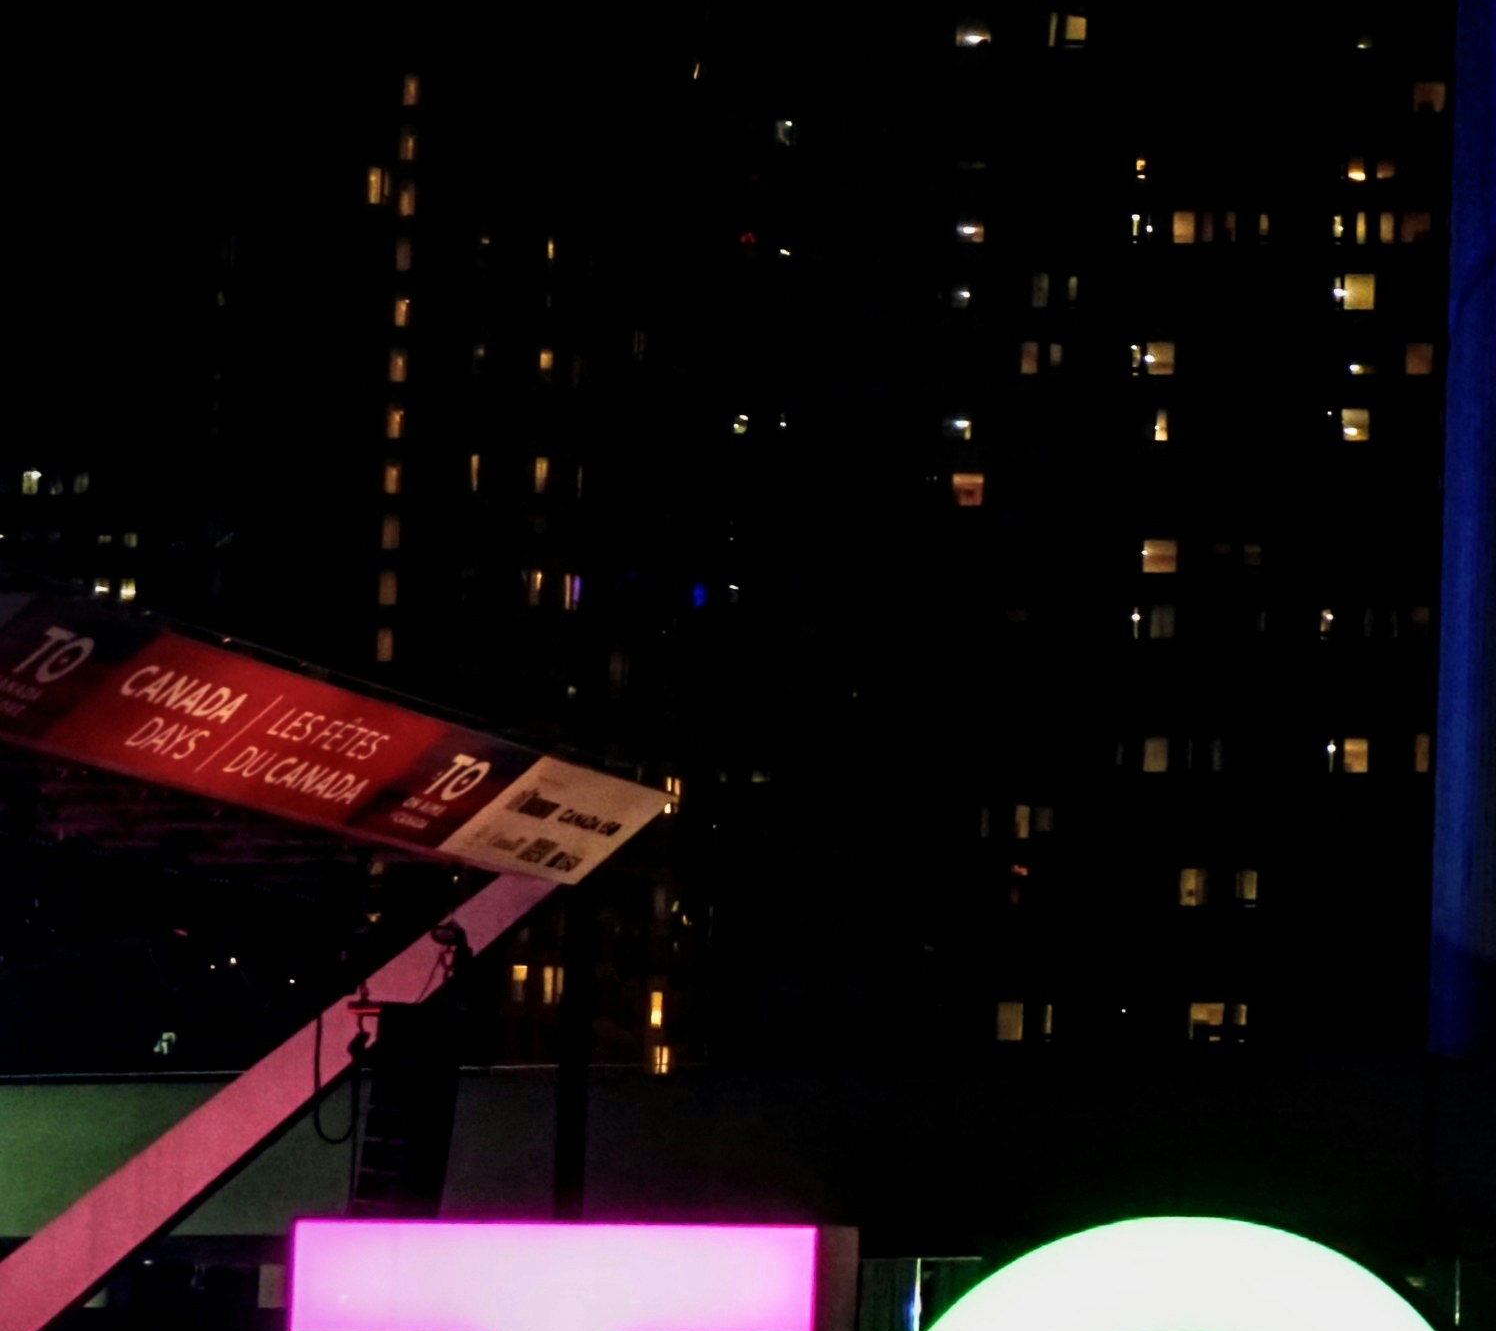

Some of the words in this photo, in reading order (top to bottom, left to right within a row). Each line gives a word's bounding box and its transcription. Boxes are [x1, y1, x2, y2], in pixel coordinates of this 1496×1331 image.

[120, 664, 249, 725] CANADA
[124, 716, 211, 760] DAYS
[266, 707, 327, 742] LES
[222, 745, 279, 778] DU
[263, 755, 372, 806] CANADA
